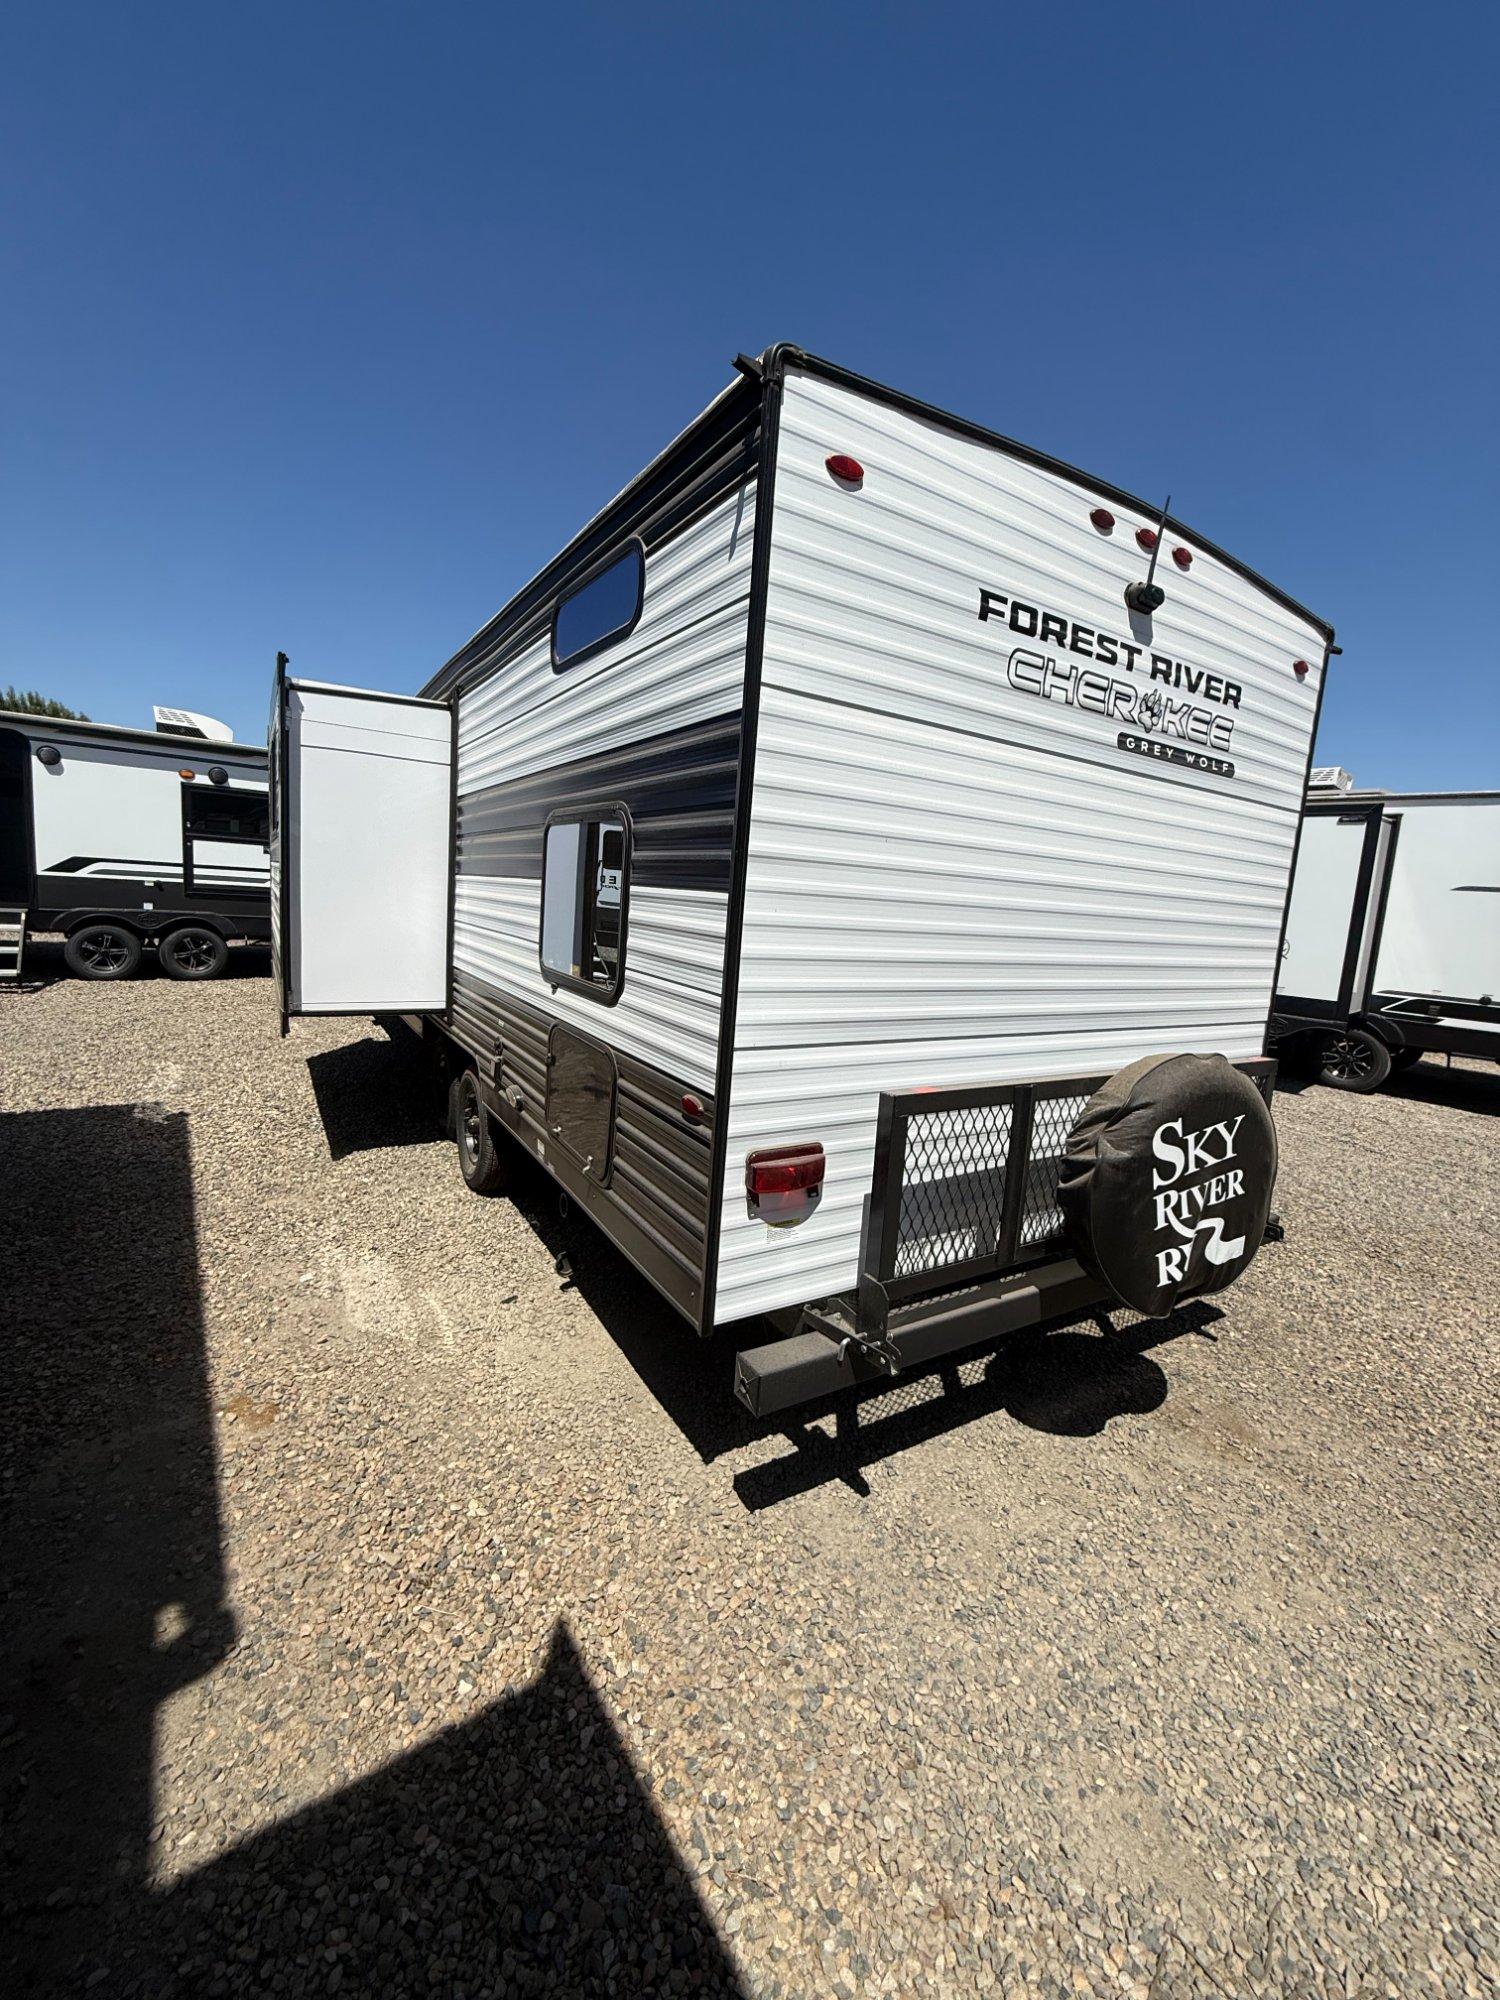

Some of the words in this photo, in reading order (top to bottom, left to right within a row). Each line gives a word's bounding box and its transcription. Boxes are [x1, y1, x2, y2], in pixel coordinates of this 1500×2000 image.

[978, 587, 1142, 672] FOREST
[1150, 653, 1242, 710] RIVER
[1126, 737, 1174, 759] GREY
[1185, 753, 1229, 773] WOLF
[1153, 1169, 1246, 1238] RIVER
